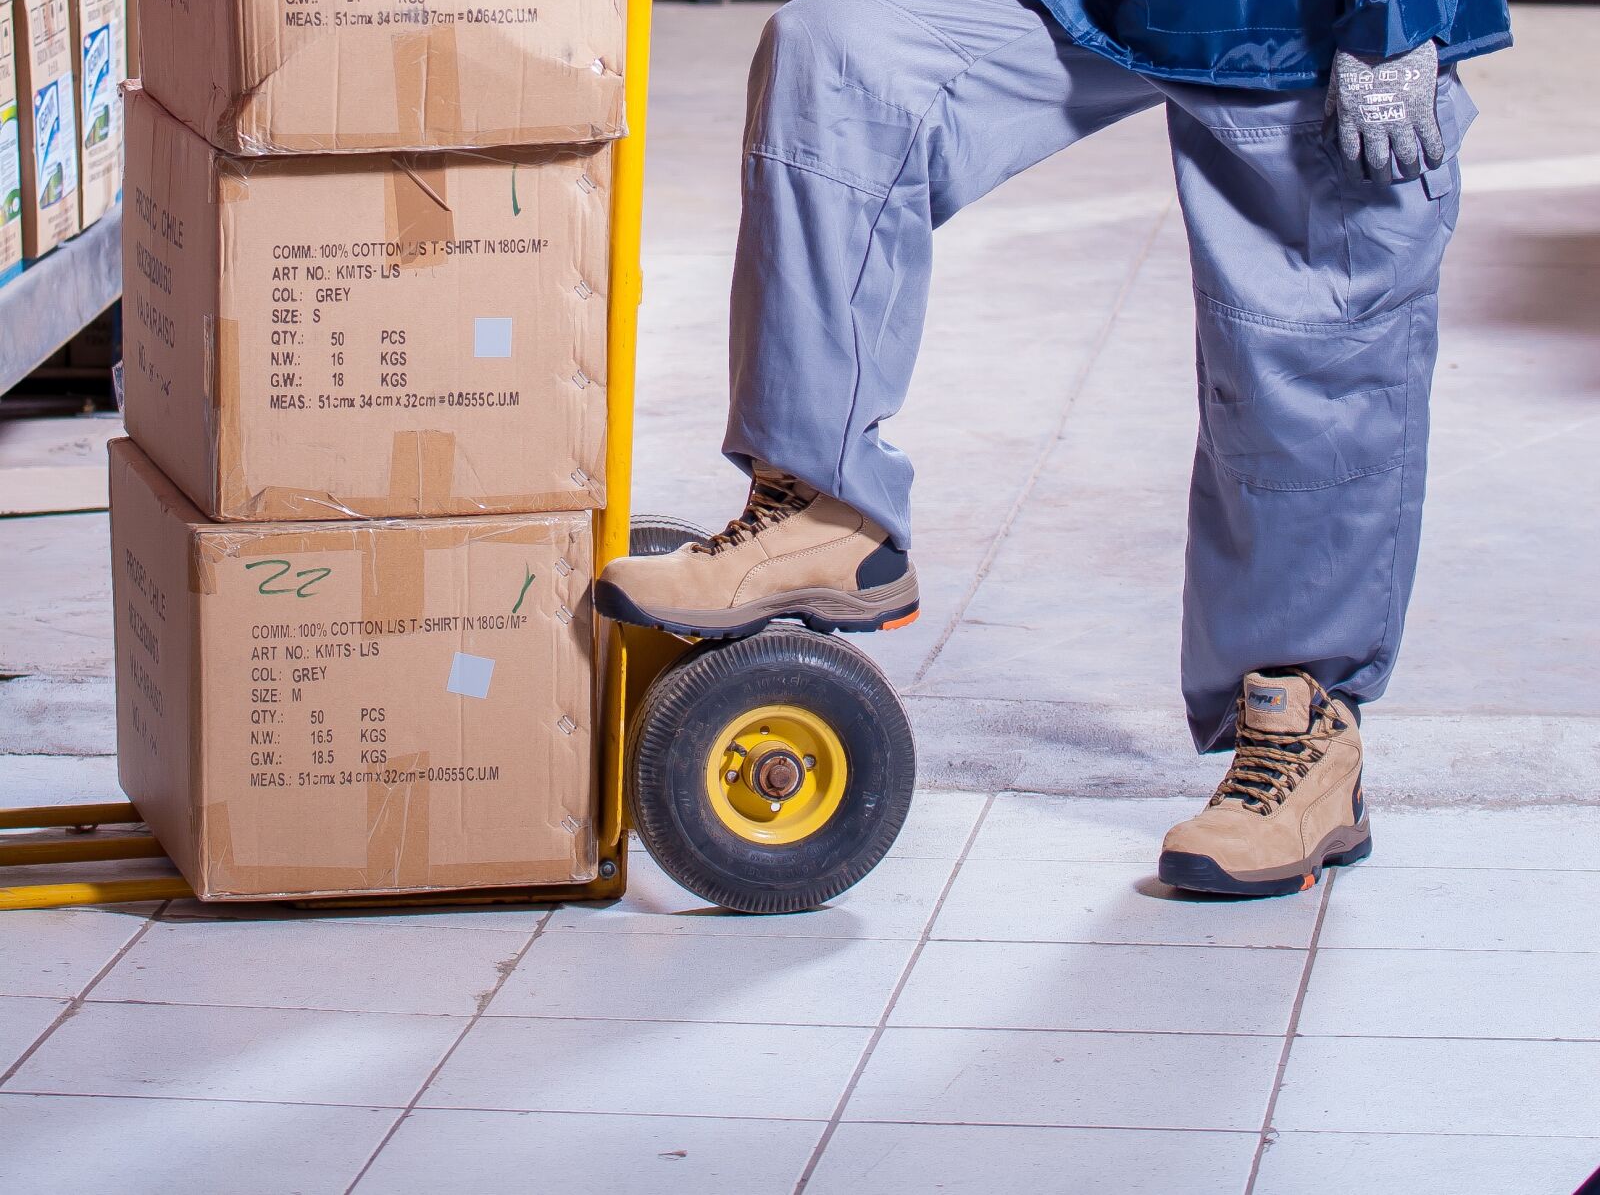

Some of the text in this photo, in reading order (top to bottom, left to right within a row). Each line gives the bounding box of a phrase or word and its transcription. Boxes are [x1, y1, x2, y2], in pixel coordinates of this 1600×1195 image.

[162, 209, 184, 249] CHILE
[319, 245, 348, 258] 100%
[352, 242, 403, 257] COTTON
[484, 240, 496, 254] IN
[273, 266, 298, 281] ART
[272, 287, 351, 303] COL: GREY
[272, 309, 321, 323] SIZE: S
[331, 331, 345, 346] 50
[381, 330, 406, 344] PCS
[332, 351, 343, 366] 16
[381, 351, 407, 365] KGS
[332, 373, 344, 387] 18
[381, 372, 407, 387] KGS
[298, 624, 327, 638] 100%
[331, 621, 383, 636] COTTON
[388, 620, 405, 634] L/S
[463, 617, 474, 631] IN
[251, 646, 277, 660] ART
[252, 667, 327, 682] COL: GREY
[252, 688, 302, 702] SIZE: M
[310, 710, 324, 724] 50
[361, 708, 385, 722] PCS
[310, 730, 333, 744] 16.5
[360, 729, 387, 743] KGS
[312, 750, 334, 764] 18.5
[360, 750, 387, 764] KGS
